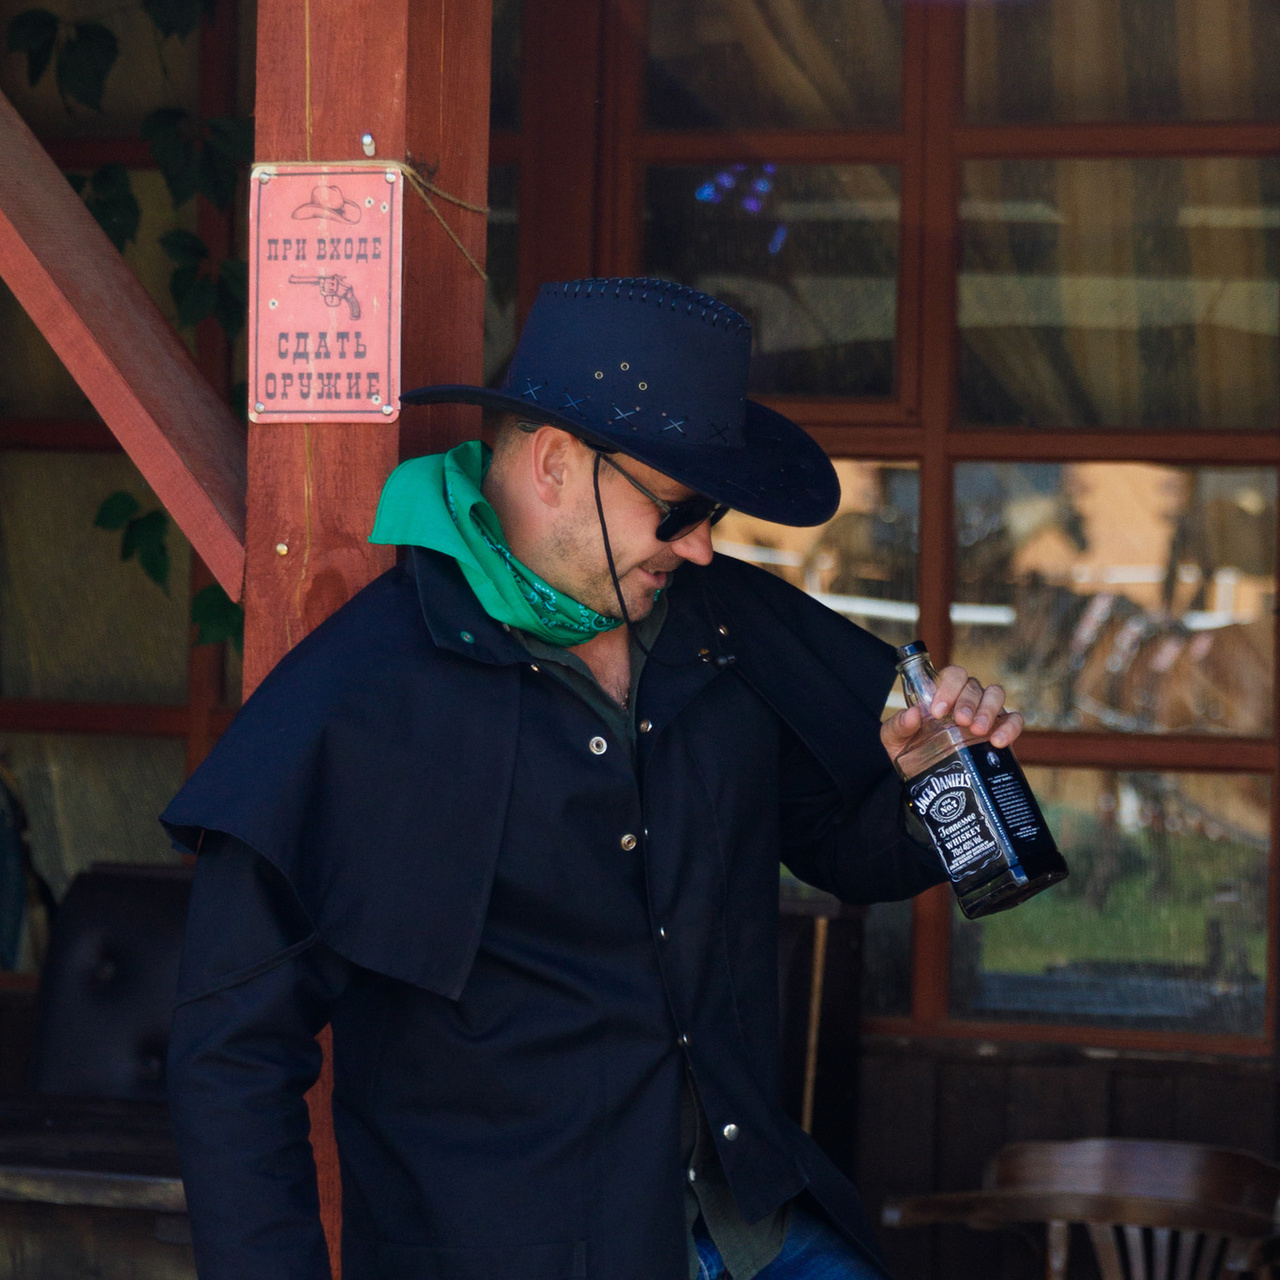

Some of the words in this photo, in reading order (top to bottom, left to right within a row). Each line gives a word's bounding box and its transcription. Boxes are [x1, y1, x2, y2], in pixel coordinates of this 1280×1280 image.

[267, 238, 307, 261] ПРИ
[316, 237, 382, 263] ВХОДЕ
[278, 332, 367, 364] СДАТЬ
[265, 372, 380, 400] ОРУЖИЕ
[914, 785, 938, 815] JACK
[938, 812, 977, 838] Tennessee
[945, 824, 981, 850] WHISKEY
